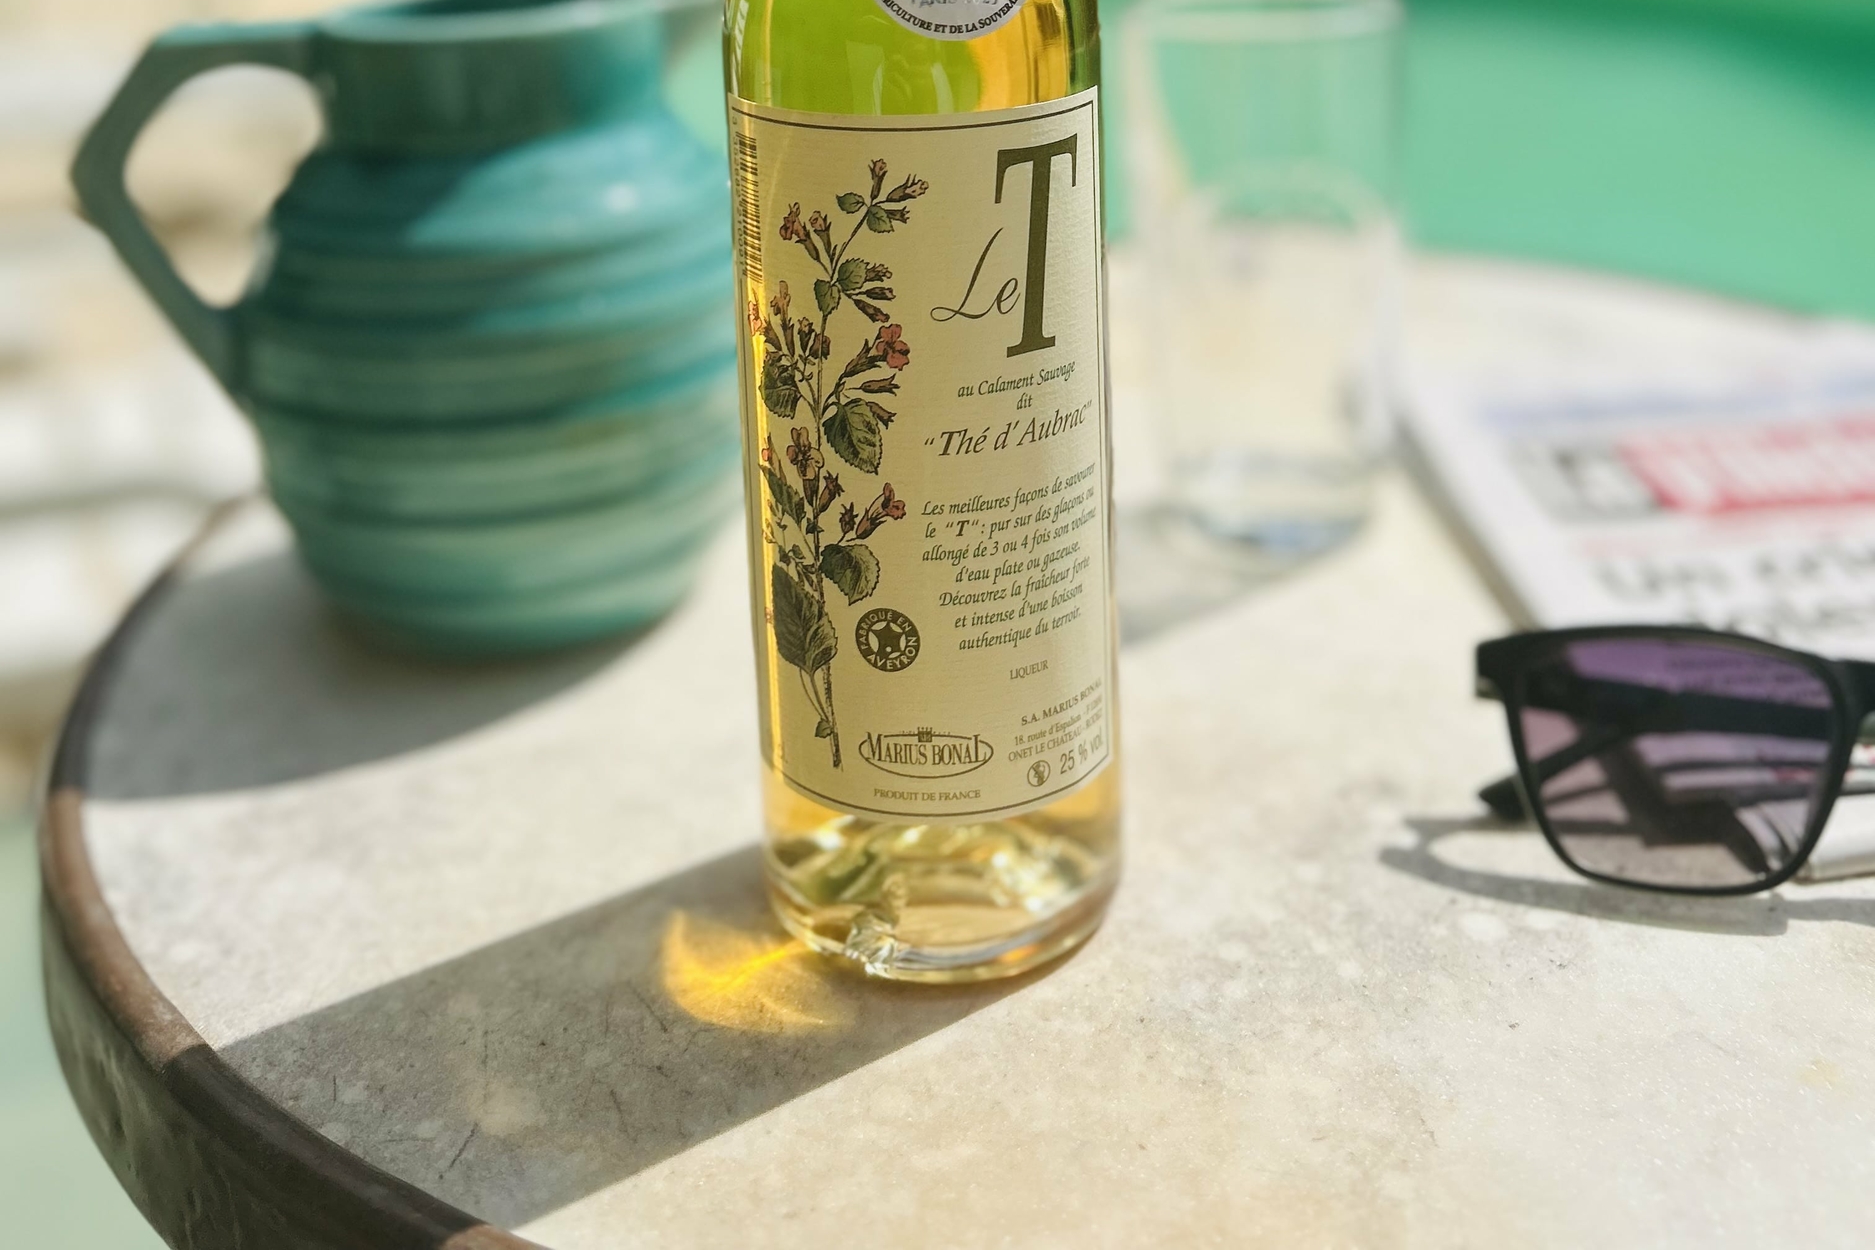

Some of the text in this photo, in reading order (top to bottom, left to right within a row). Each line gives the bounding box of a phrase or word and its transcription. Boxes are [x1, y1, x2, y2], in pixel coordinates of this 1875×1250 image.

[933, 23, 948, 34] ET
[949, 24, 964, 34] DE
[965, 23, 978, 33] LA
[930, 133, 1077, 358] Le T
[957, 361, 1076, 398] au Calament Sauvage
[1016, 393, 1033, 410] dit
[921, 463, 1095, 516] Les meilleures façons de savourer
[925, 522, 936, 538] le
[988, 518, 1011, 539] pur
[1013, 513, 1033, 528] sur
[1035, 506, 1051, 523] des
[1052, 495, 1086, 523] glaçons
[1086, 485, 1095, 498] ou
[922, 507, 1096, 566] allongé de 3 ou 4 fois son volume
[938, 555, 1091, 607] Découvrez la fraîcheur forte
[955, 542, 1080, 584] d'eau plate ou gazeuse.
[954, 583, 1083, 629] et intense d'une boisson
[858, 611, 918, 669] FABRIQUE EN AVEYRON
[959, 605, 1081, 650] authentique du terroir.
[1009, 660, 1049, 680] LIQUEUR
[1021, 713, 1040, 726] S.A.
[1042, 695, 1079, 719] MARIUS
[865, 731, 987, 765] MARIUS BONAL
[1008, 746, 1034, 762] ONET
[1035, 742, 1046, 754] LE
[1027, 730, 1047, 742] route
[1060, 749, 1075, 774] 25
[1078, 739, 1088, 764] %
[874, 788, 981, 801] PRODUIT DE FRANCE
